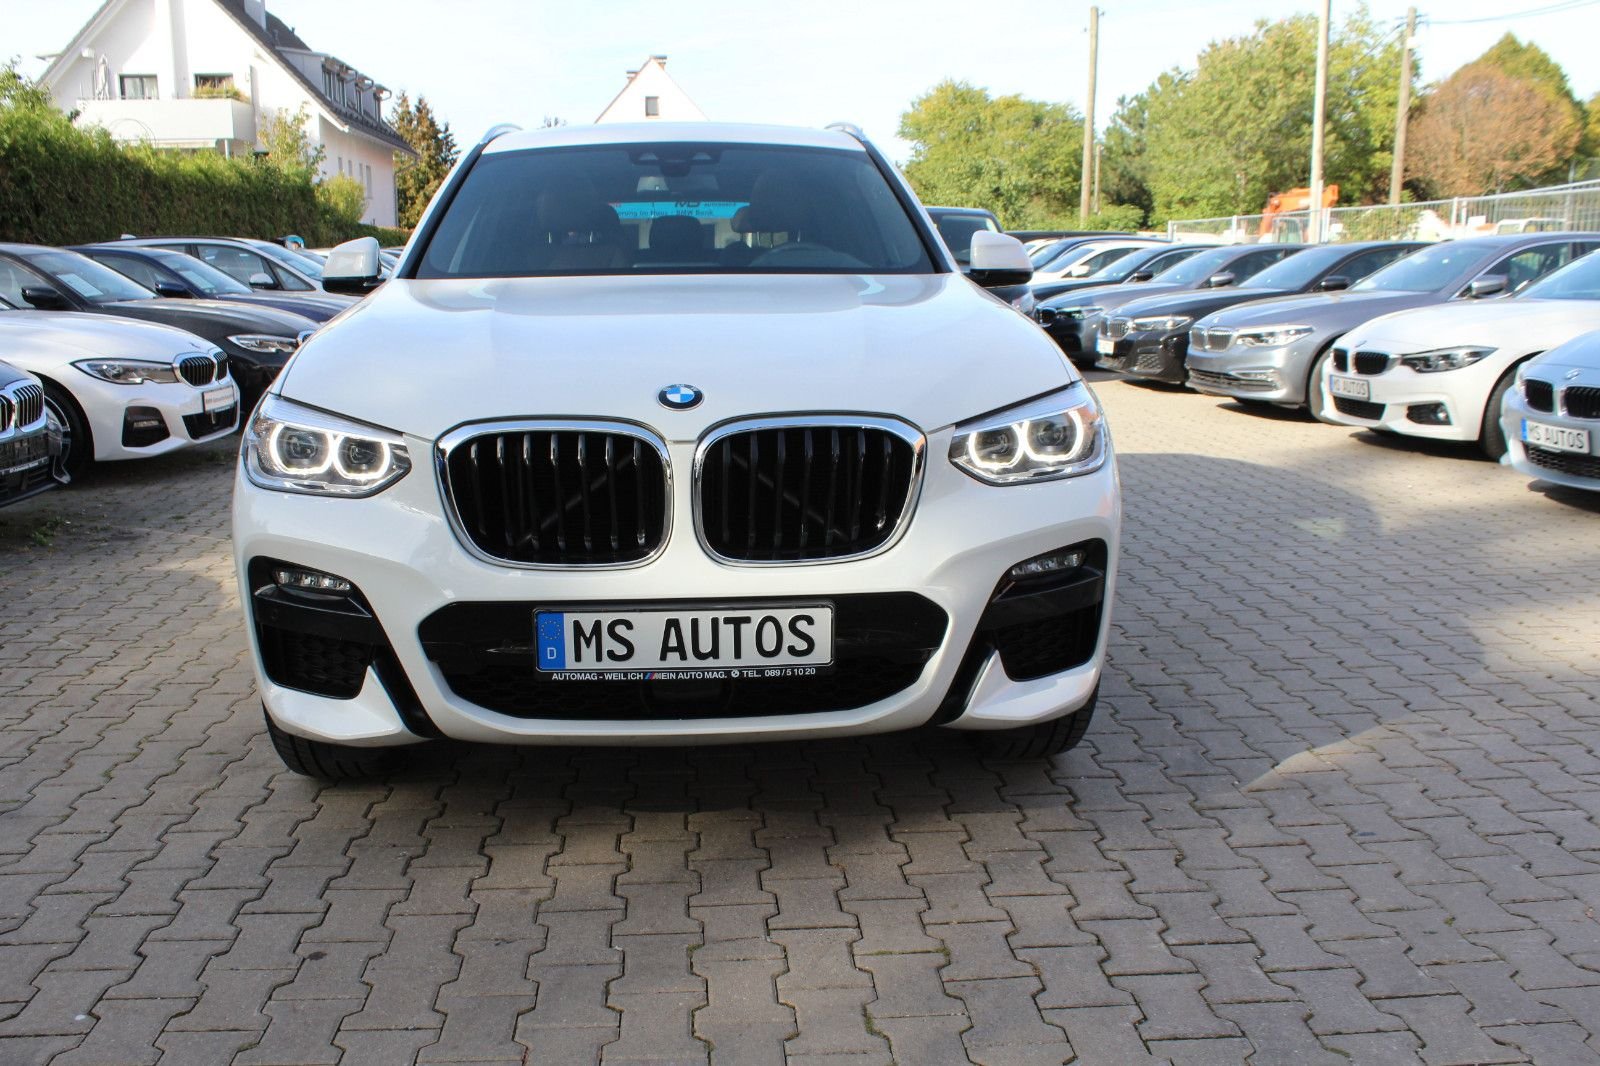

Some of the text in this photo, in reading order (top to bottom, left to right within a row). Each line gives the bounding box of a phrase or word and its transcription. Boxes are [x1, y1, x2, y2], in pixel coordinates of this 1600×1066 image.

[1544, 427, 1584, 449] AUTOS
[573, 615, 815, 662] MS AUTOS
[547, 647, 556, 659] D
[705, 671, 727, 679] MAG.
